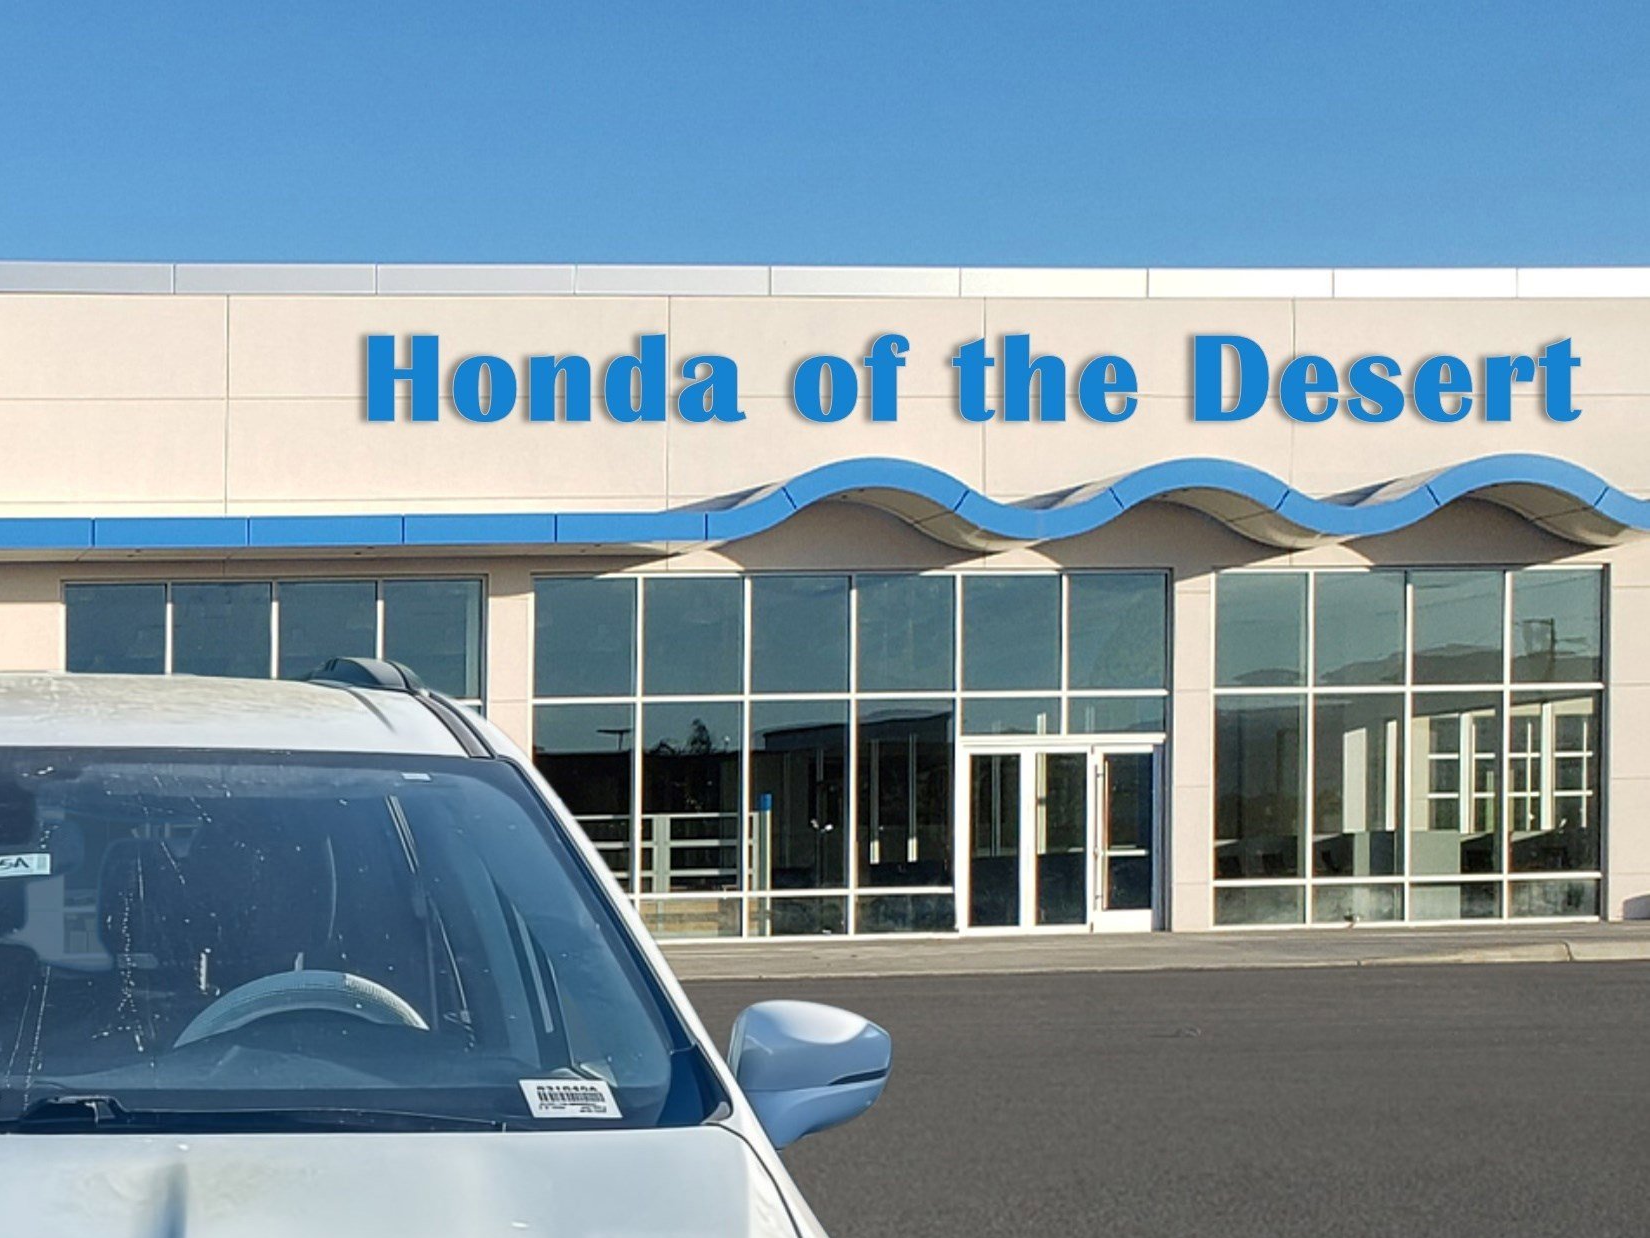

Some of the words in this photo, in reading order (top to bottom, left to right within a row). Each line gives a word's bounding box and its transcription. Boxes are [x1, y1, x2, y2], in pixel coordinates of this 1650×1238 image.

[367, 334, 746, 424] Honda
[792, 333, 910, 424] of
[952, 333, 1138, 424] the
[1194, 334, 1582, 424] Desert
